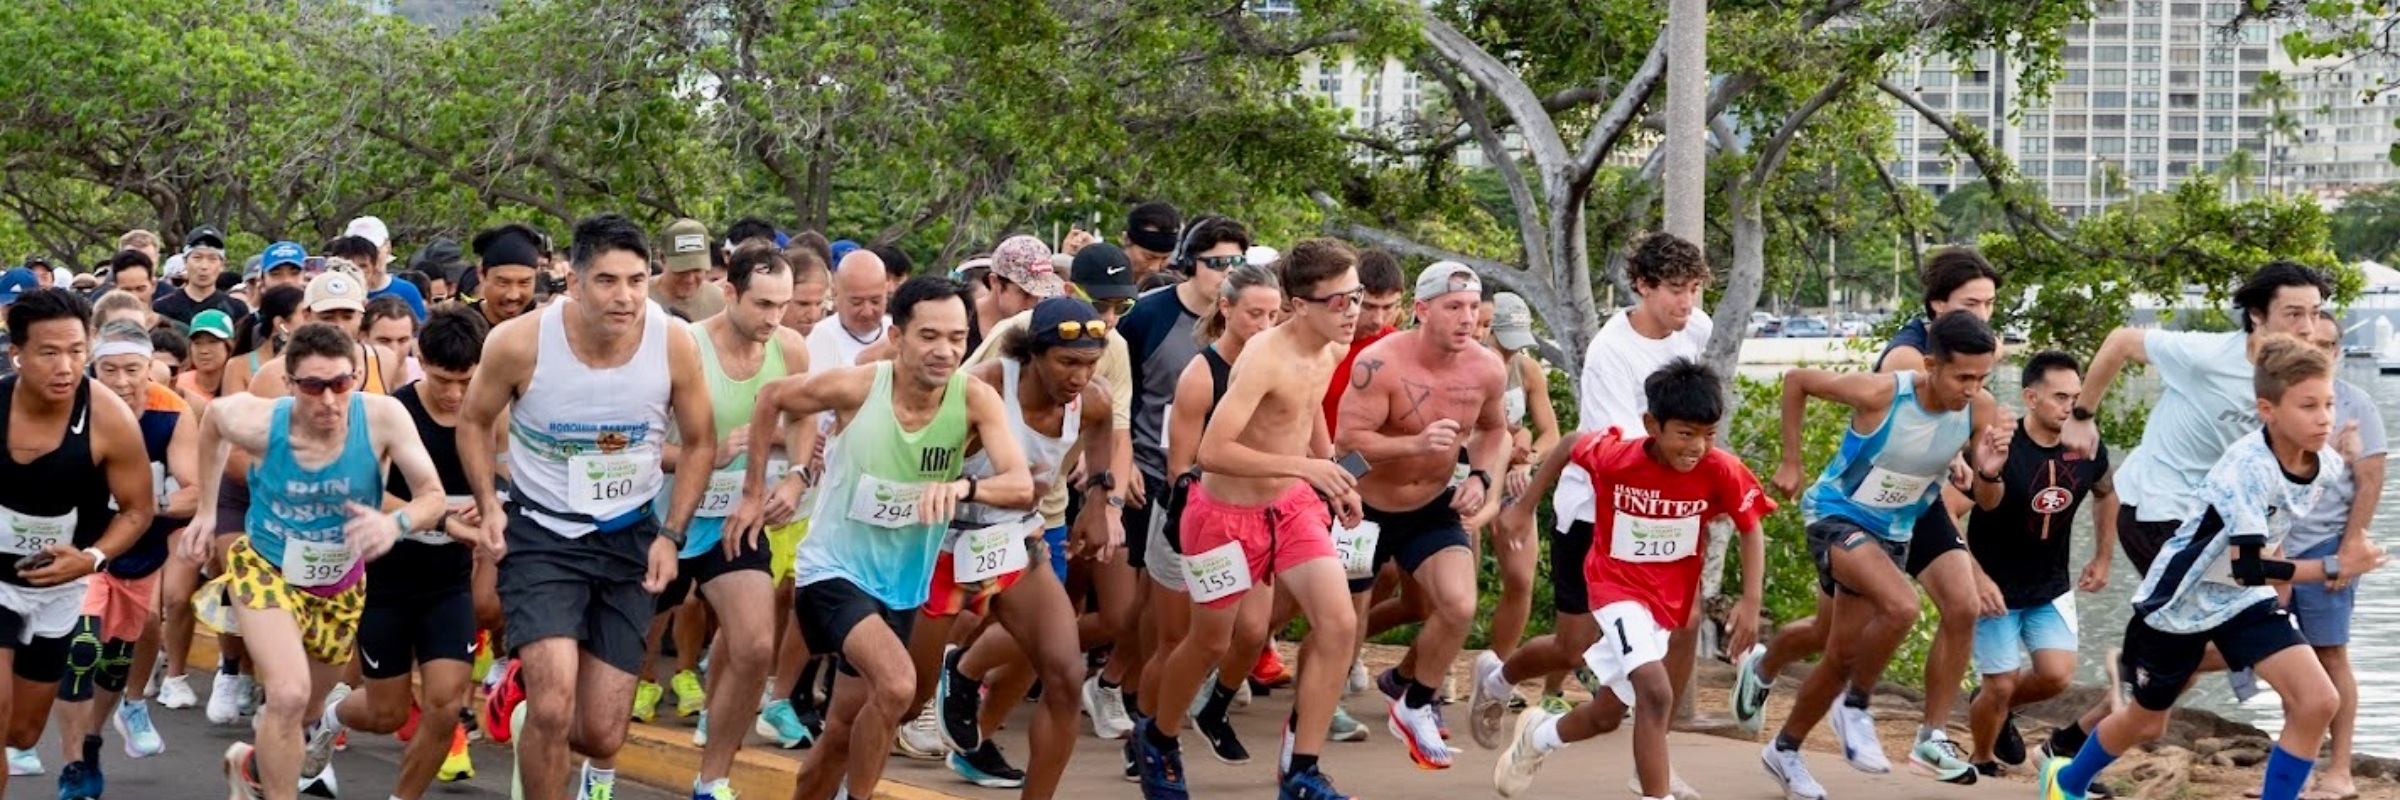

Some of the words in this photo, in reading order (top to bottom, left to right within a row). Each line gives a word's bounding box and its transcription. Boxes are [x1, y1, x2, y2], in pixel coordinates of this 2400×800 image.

[592, 478, 633, 501] 160
[1614, 483, 1661, 500] HAWAII
[873, 503, 913, 521] 294
[1612, 491, 1709, 518] UNITED
[1634, 540, 1676, 556] 210
[976, 547, 1007, 573] 287
[303, 564, 344, 580] 395
[1199, 570, 1237, 595] 155
[1614, 617, 1633, 656] 1
